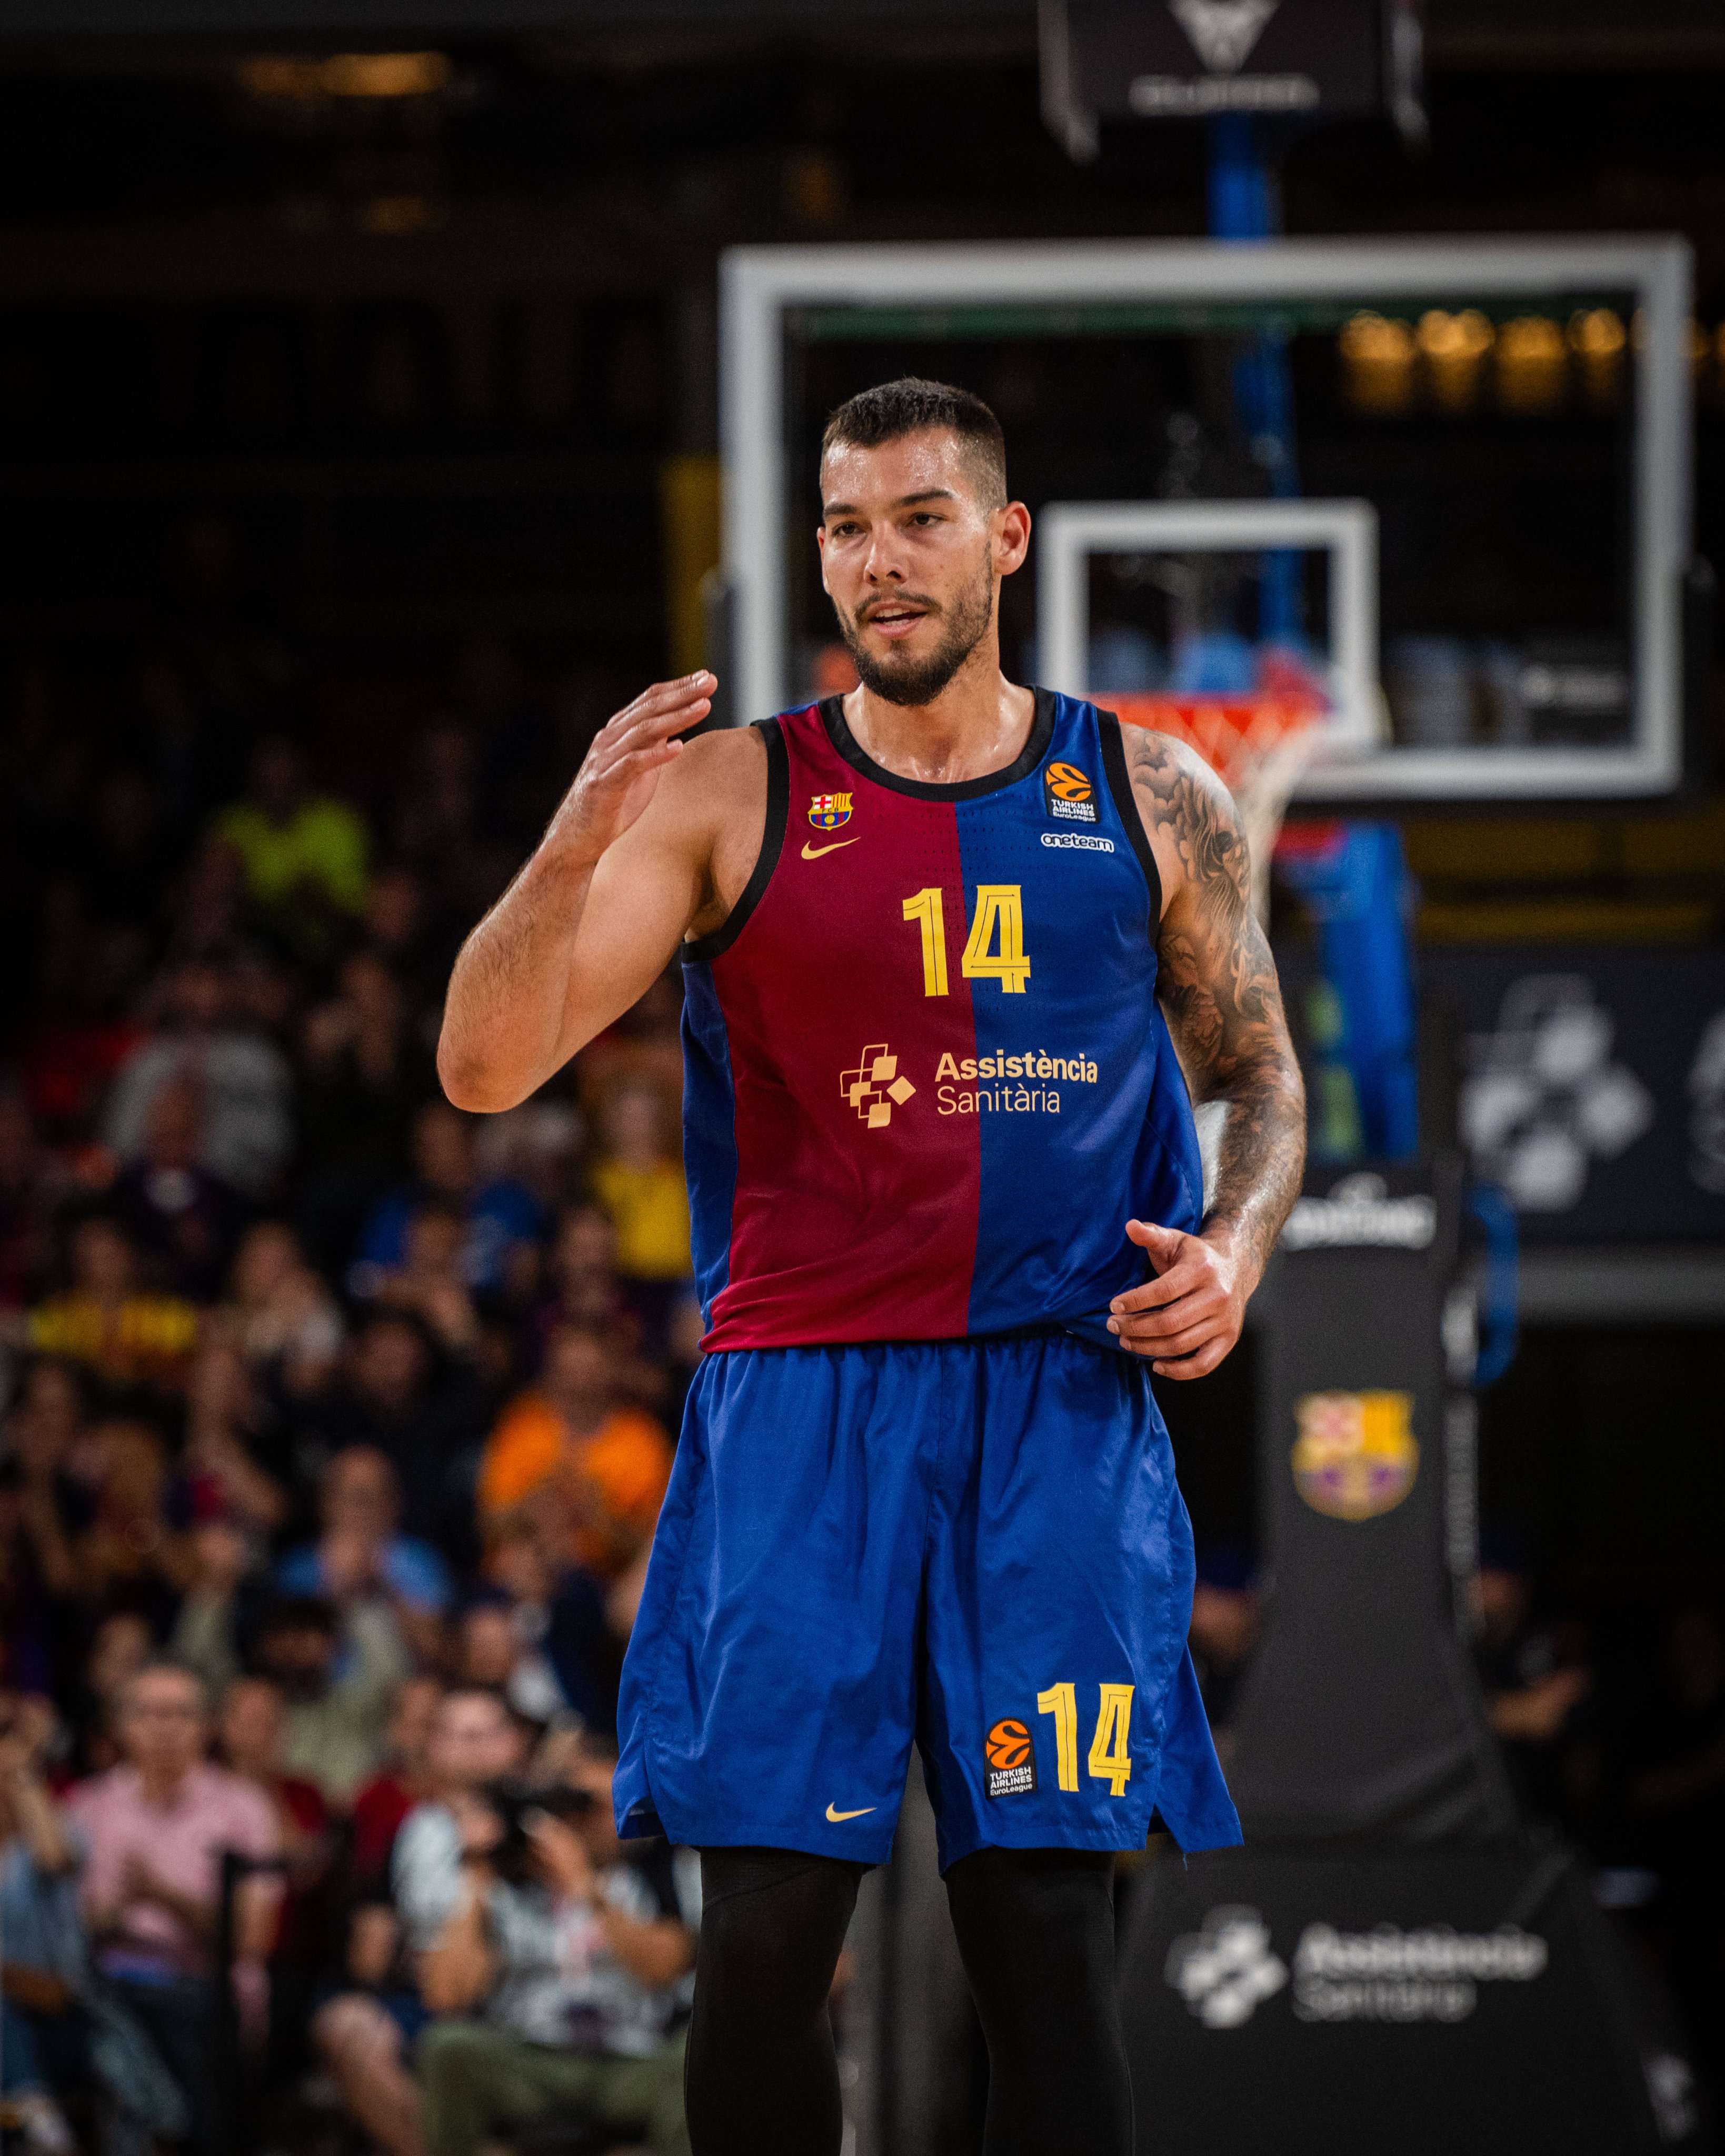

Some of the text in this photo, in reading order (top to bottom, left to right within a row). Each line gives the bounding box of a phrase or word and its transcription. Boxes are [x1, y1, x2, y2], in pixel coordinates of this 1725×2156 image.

[1051, 799, 1093, 810] TURKISH
[1053, 806, 1095, 816] AIRLINES
[1042, 834, 1113, 852] oneteam
[902, 885, 1031, 996] 14
[935, 1049, 1098, 1083] Assistència
[937, 1083, 1060, 1115] Sanitària
[1037, 1682, 1135, 1796] 14
[990, 1766, 1031, 1782] TURKISH
[990, 1774, 1032, 1790] AIRLINES
[990, 1783, 1033, 1796] EuroLeague
